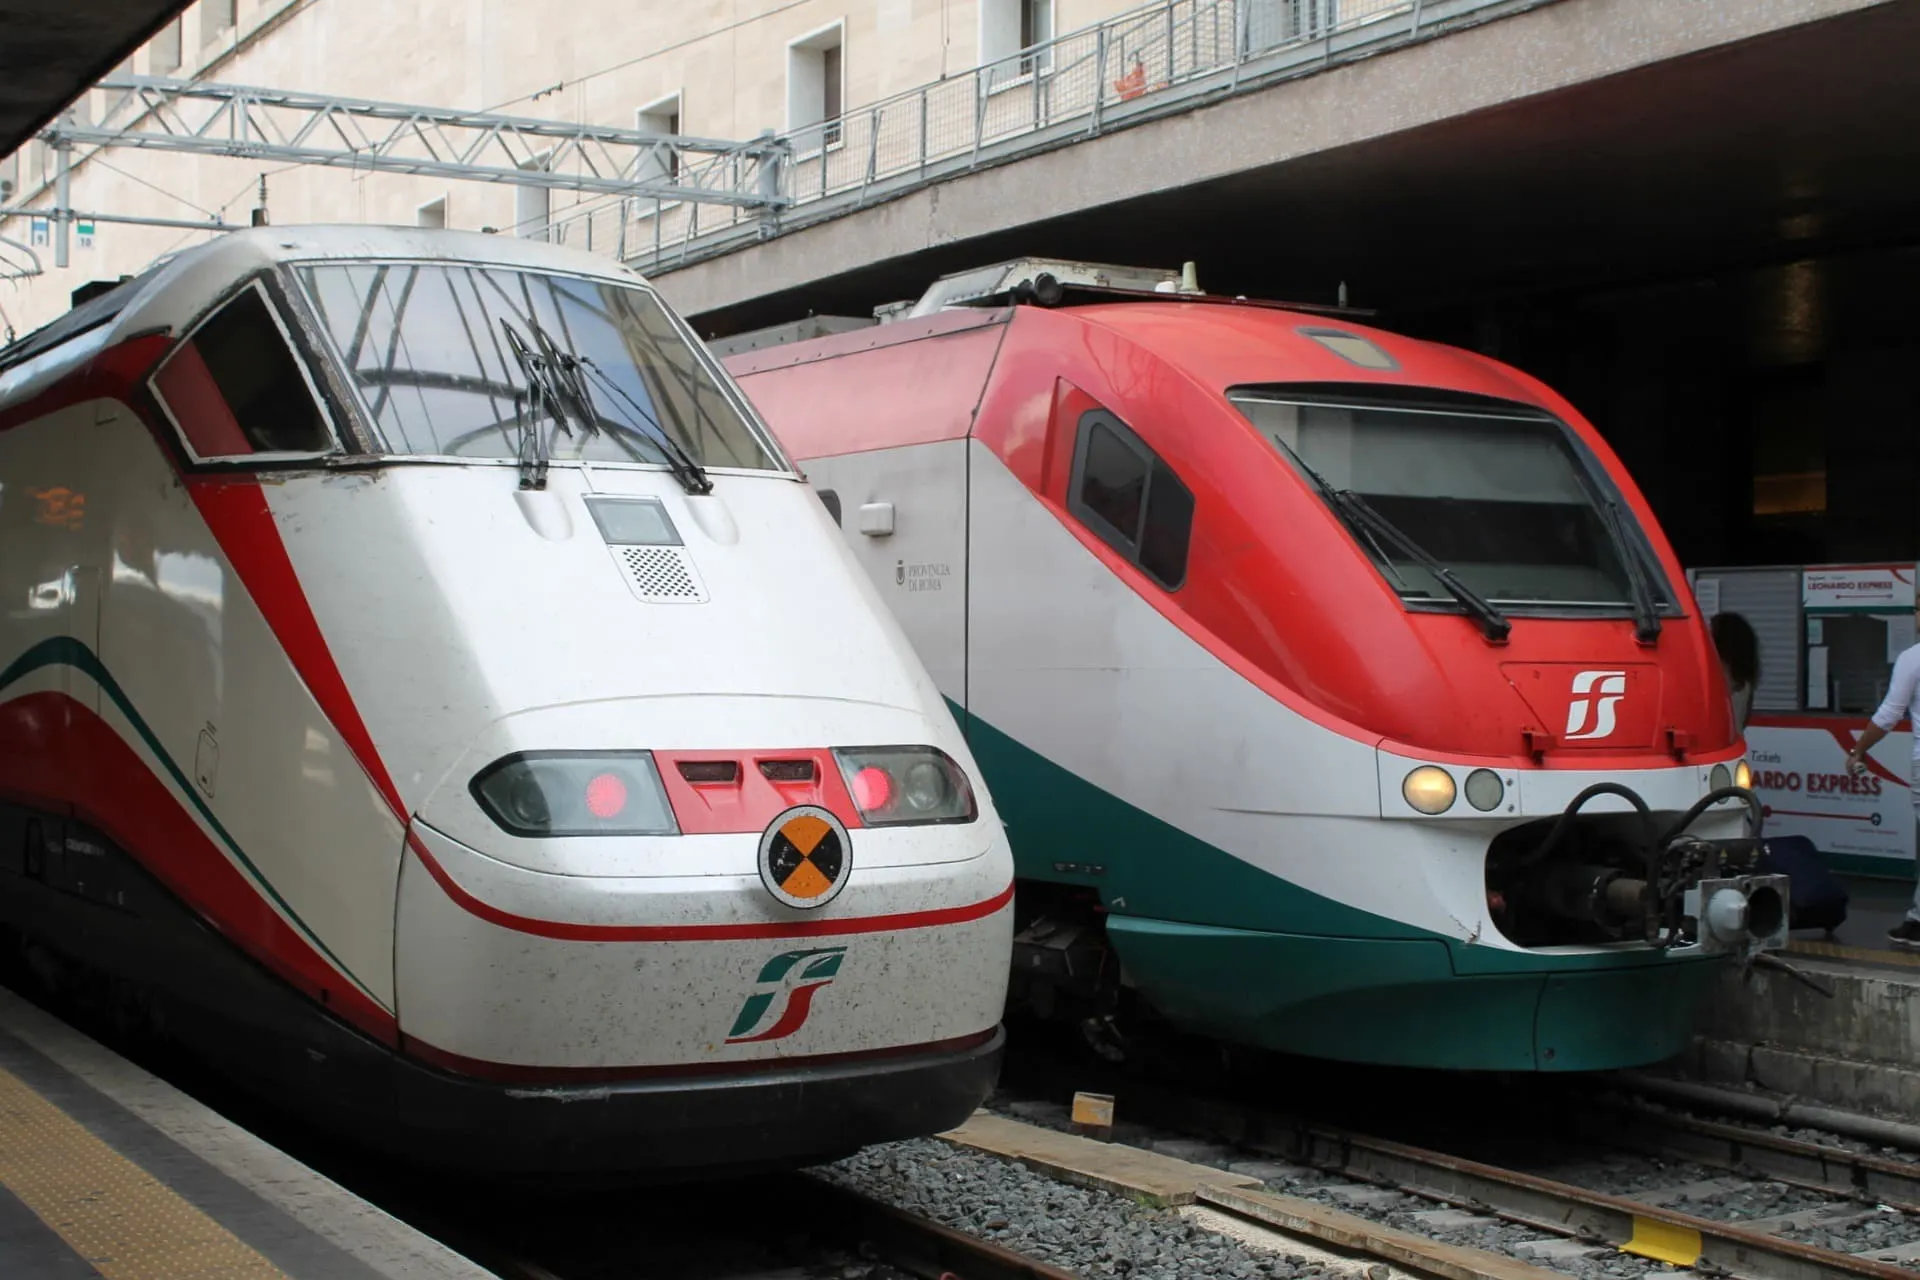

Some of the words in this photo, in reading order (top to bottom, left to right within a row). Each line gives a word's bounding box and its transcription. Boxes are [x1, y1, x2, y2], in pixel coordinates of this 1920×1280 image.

[80, 237, 92, 247] 10
[908, 563, 951, 577] PROVINCIA
[908, 579, 917, 592] DI
[1808, 581, 1855, 590] LEONARDO
[1750, 769, 1802, 791] ARDO
[1806, 773, 1882, 796] EXPRESS
